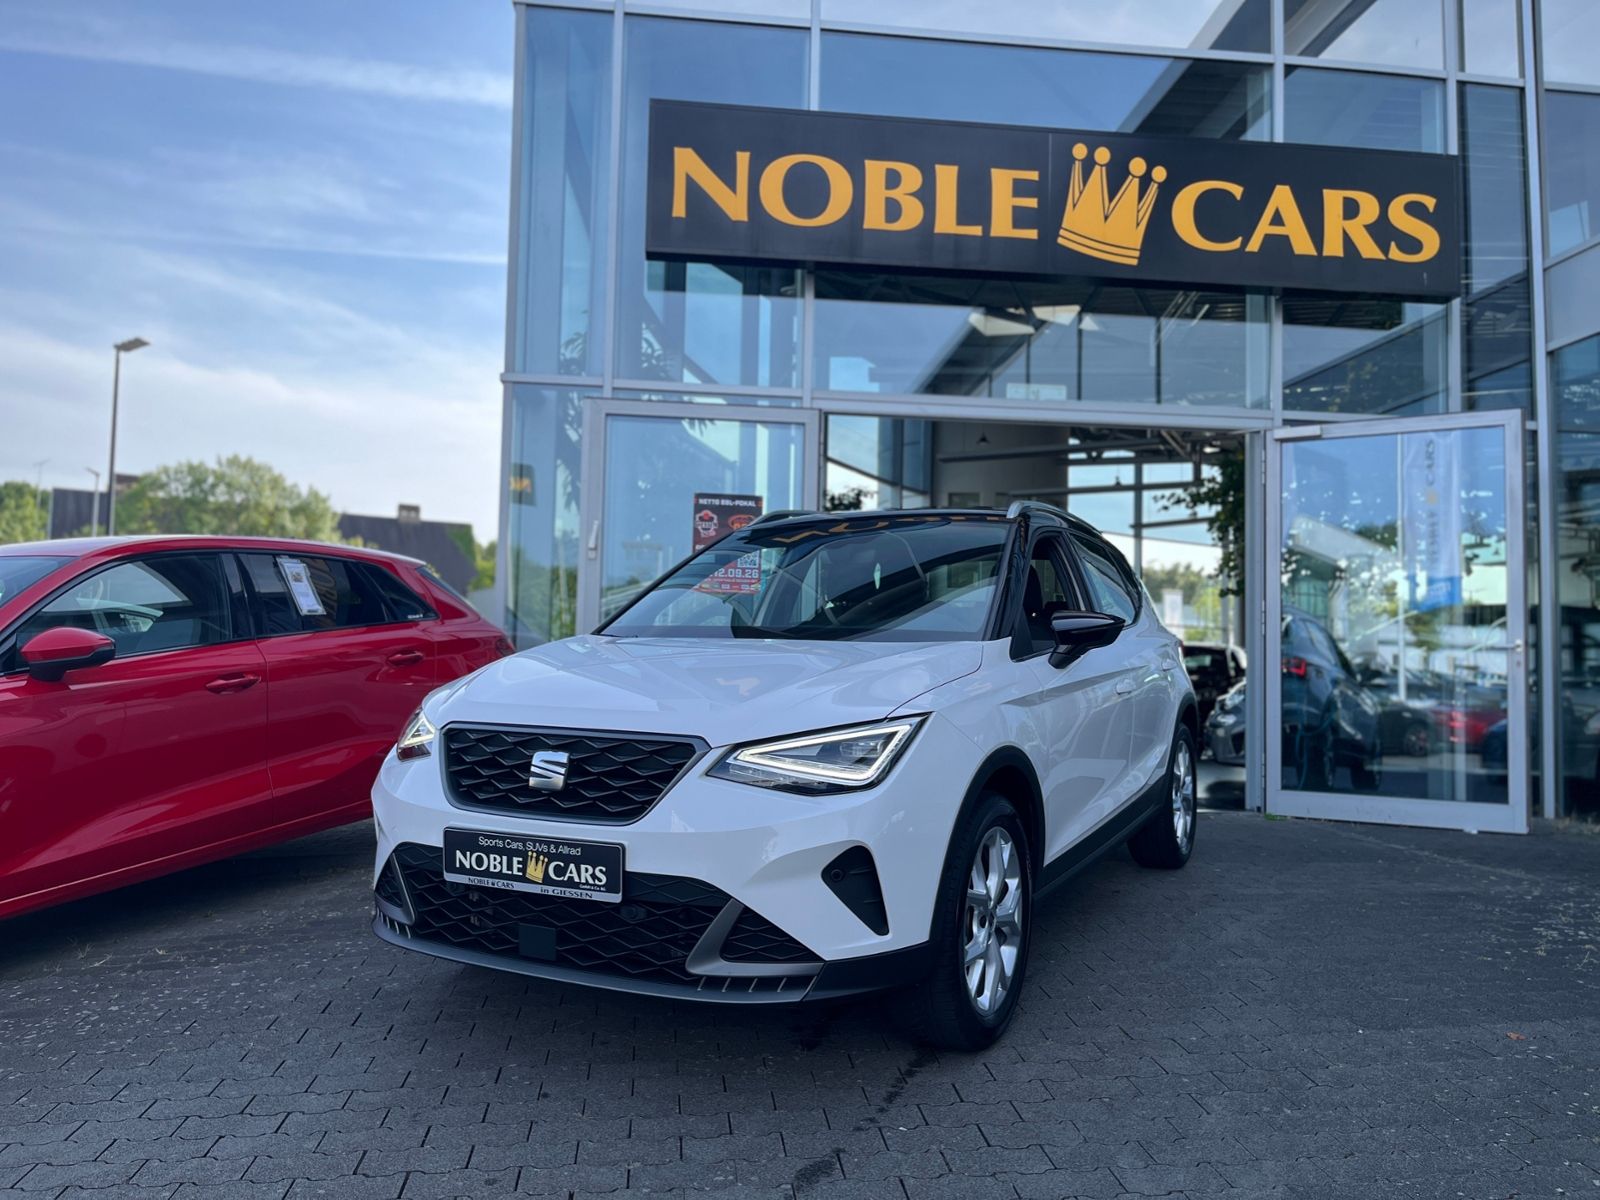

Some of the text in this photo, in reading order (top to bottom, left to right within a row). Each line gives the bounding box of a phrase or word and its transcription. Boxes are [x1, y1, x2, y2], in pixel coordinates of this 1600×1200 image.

[671, 146, 1442, 264] NOBLE CARS
[478, 836, 581, 856] Sports Cars, SUVs & Allrad
[456, 849, 607, 886] NOBLE CARS
[468, 877, 593, 899] NOBLE CARS in GIESSEN
